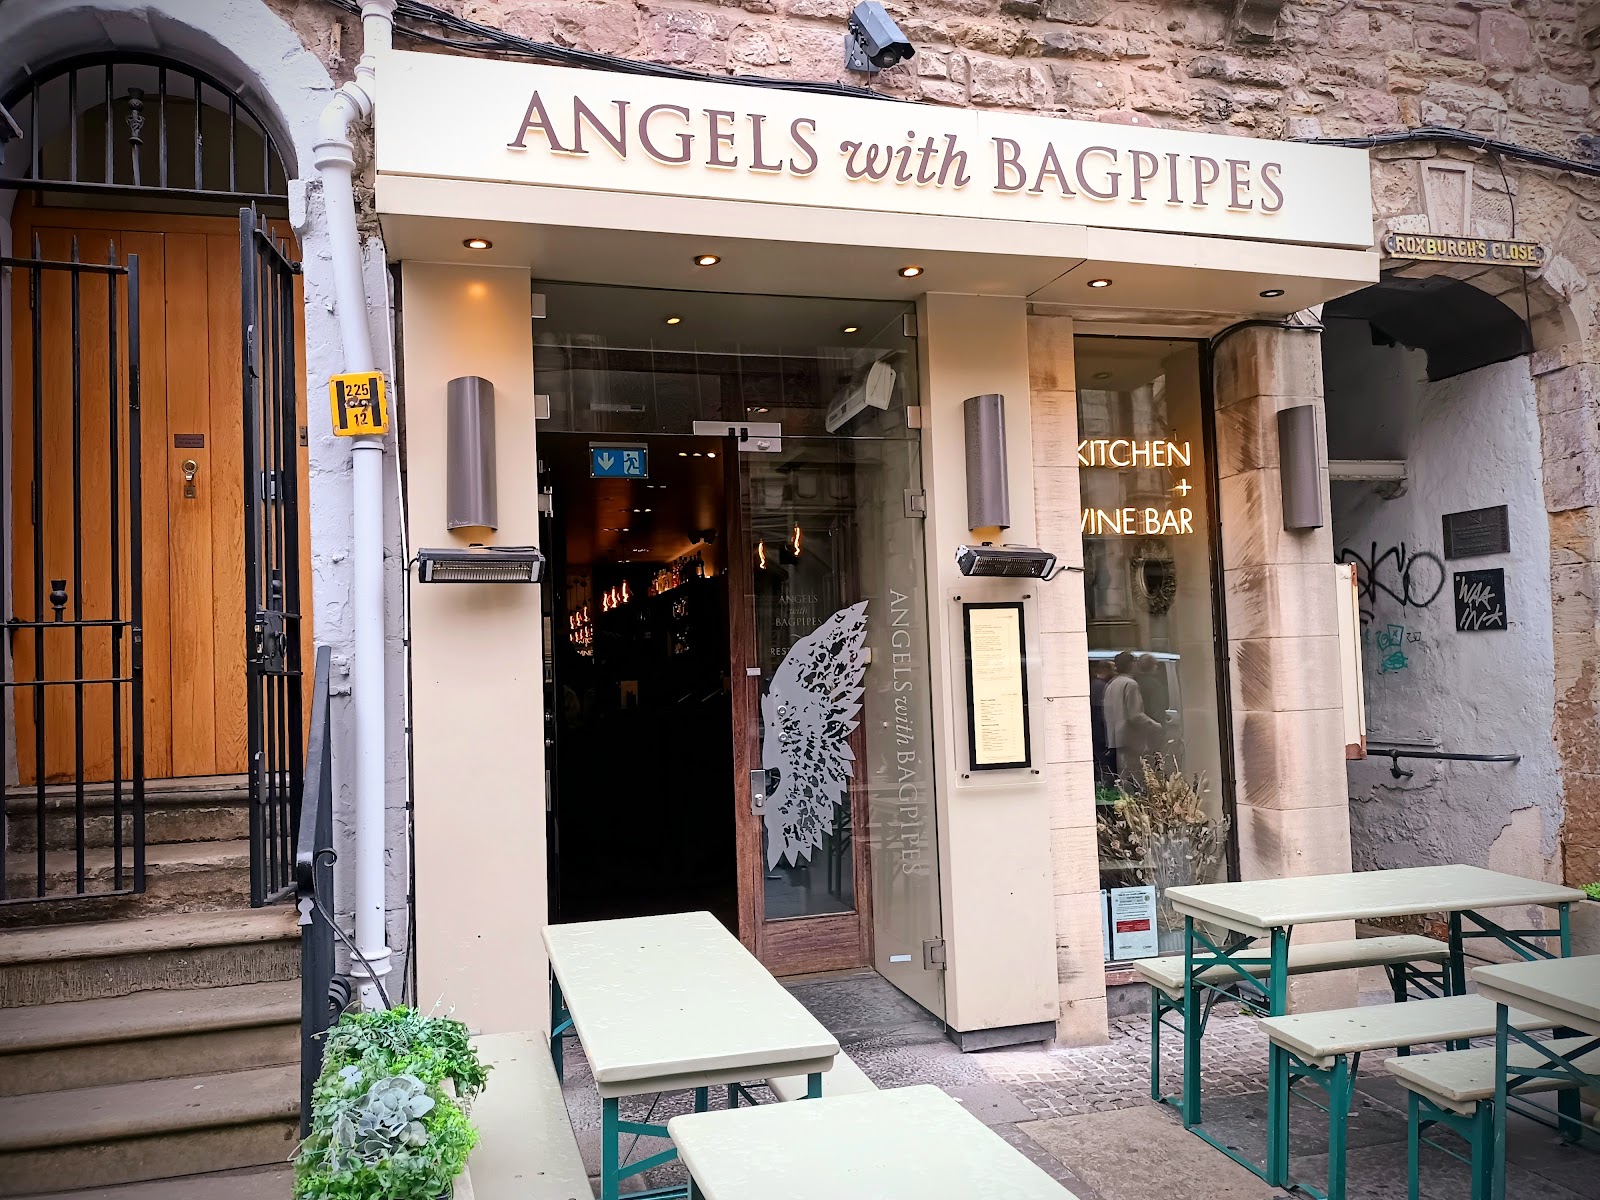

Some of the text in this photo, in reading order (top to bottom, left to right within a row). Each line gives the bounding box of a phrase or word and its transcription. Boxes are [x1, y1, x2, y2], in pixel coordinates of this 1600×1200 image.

[507, 90, 1284, 213] ANGELS with BAGPIPES
[1395, 235, 1537, 261] ROXBURGH'S CLOSE
[346, 383, 369, 397] 225
[353, 412, 368, 427] 12
[1145, 507, 1193, 535] BAR
[779, 594, 818, 604] ANGELS
[775, 617, 822, 627] BAGPIPES
[889, 589, 920, 876] ANGELS with BAGPIPES
